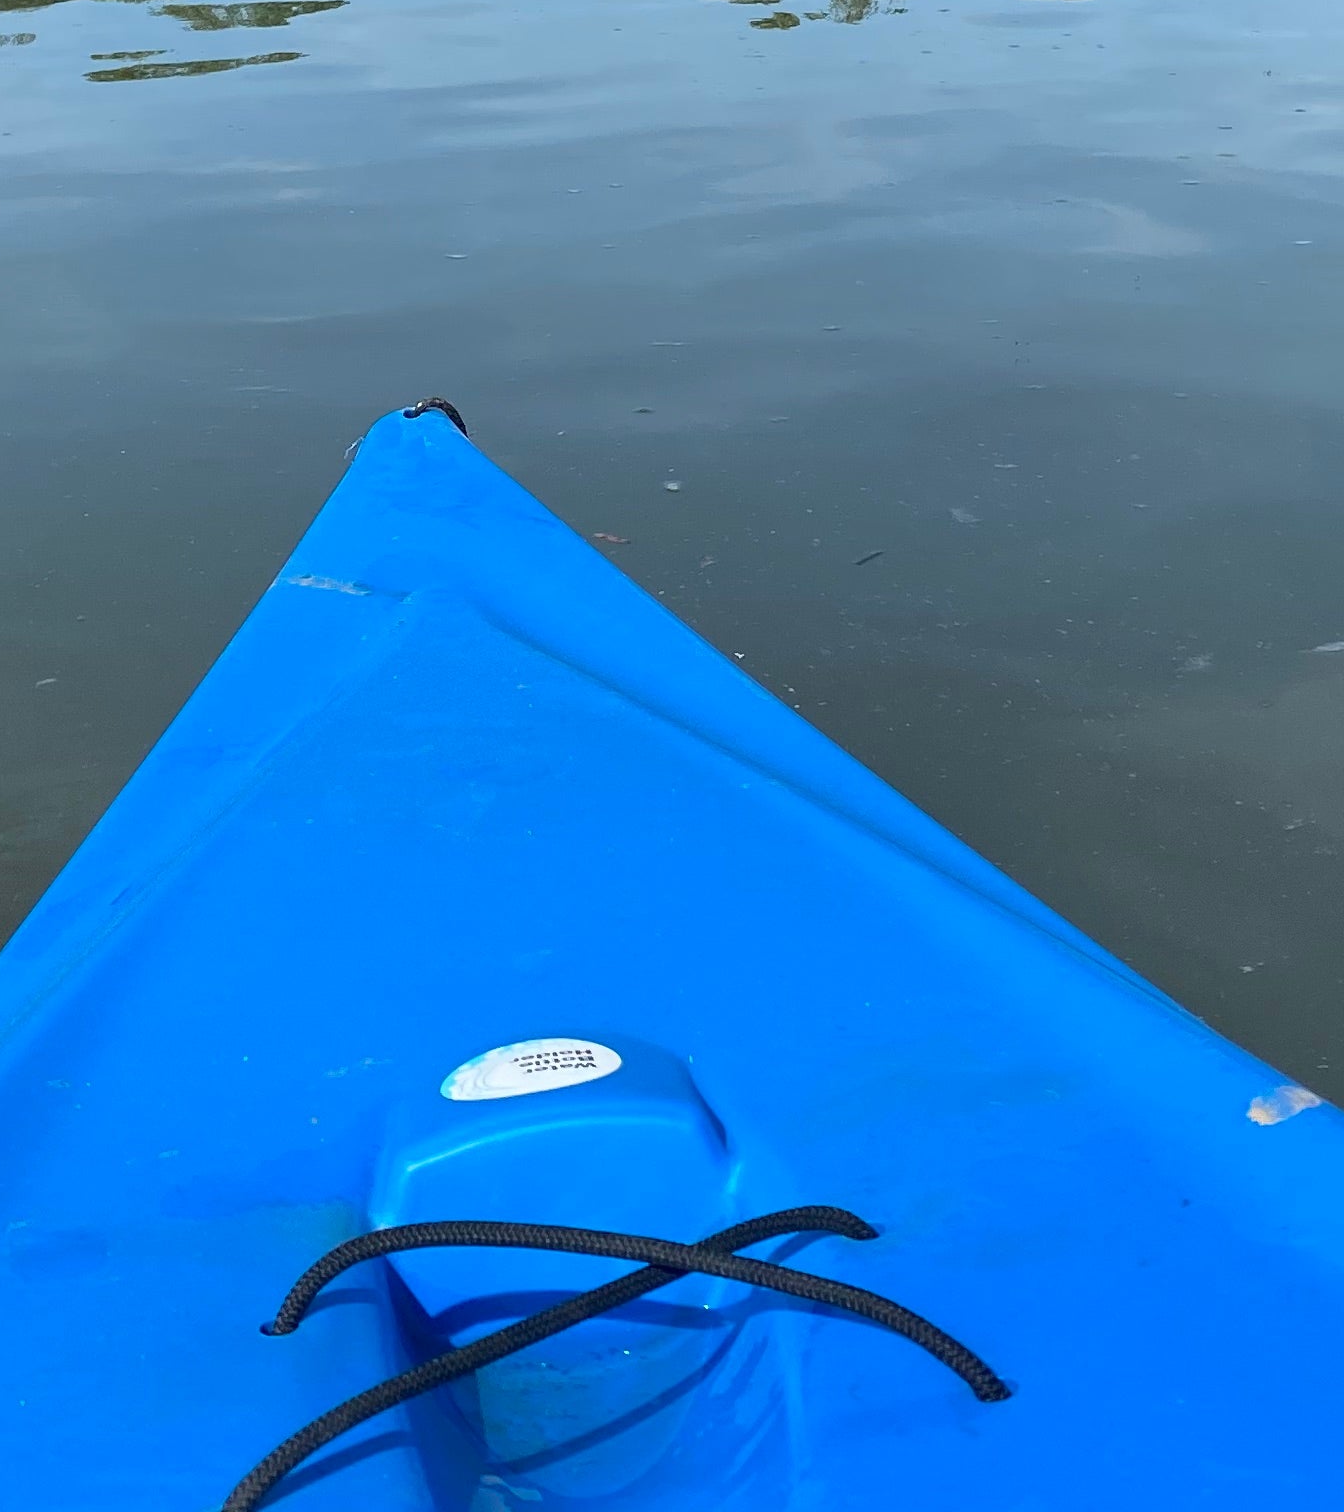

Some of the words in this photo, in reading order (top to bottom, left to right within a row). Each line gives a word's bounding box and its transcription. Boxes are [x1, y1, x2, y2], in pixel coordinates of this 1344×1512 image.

[510, 1049, 592, 1063] Holder
[519, 1055, 595, 1067] Bottle
[522, 1062, 597, 1075] Water
